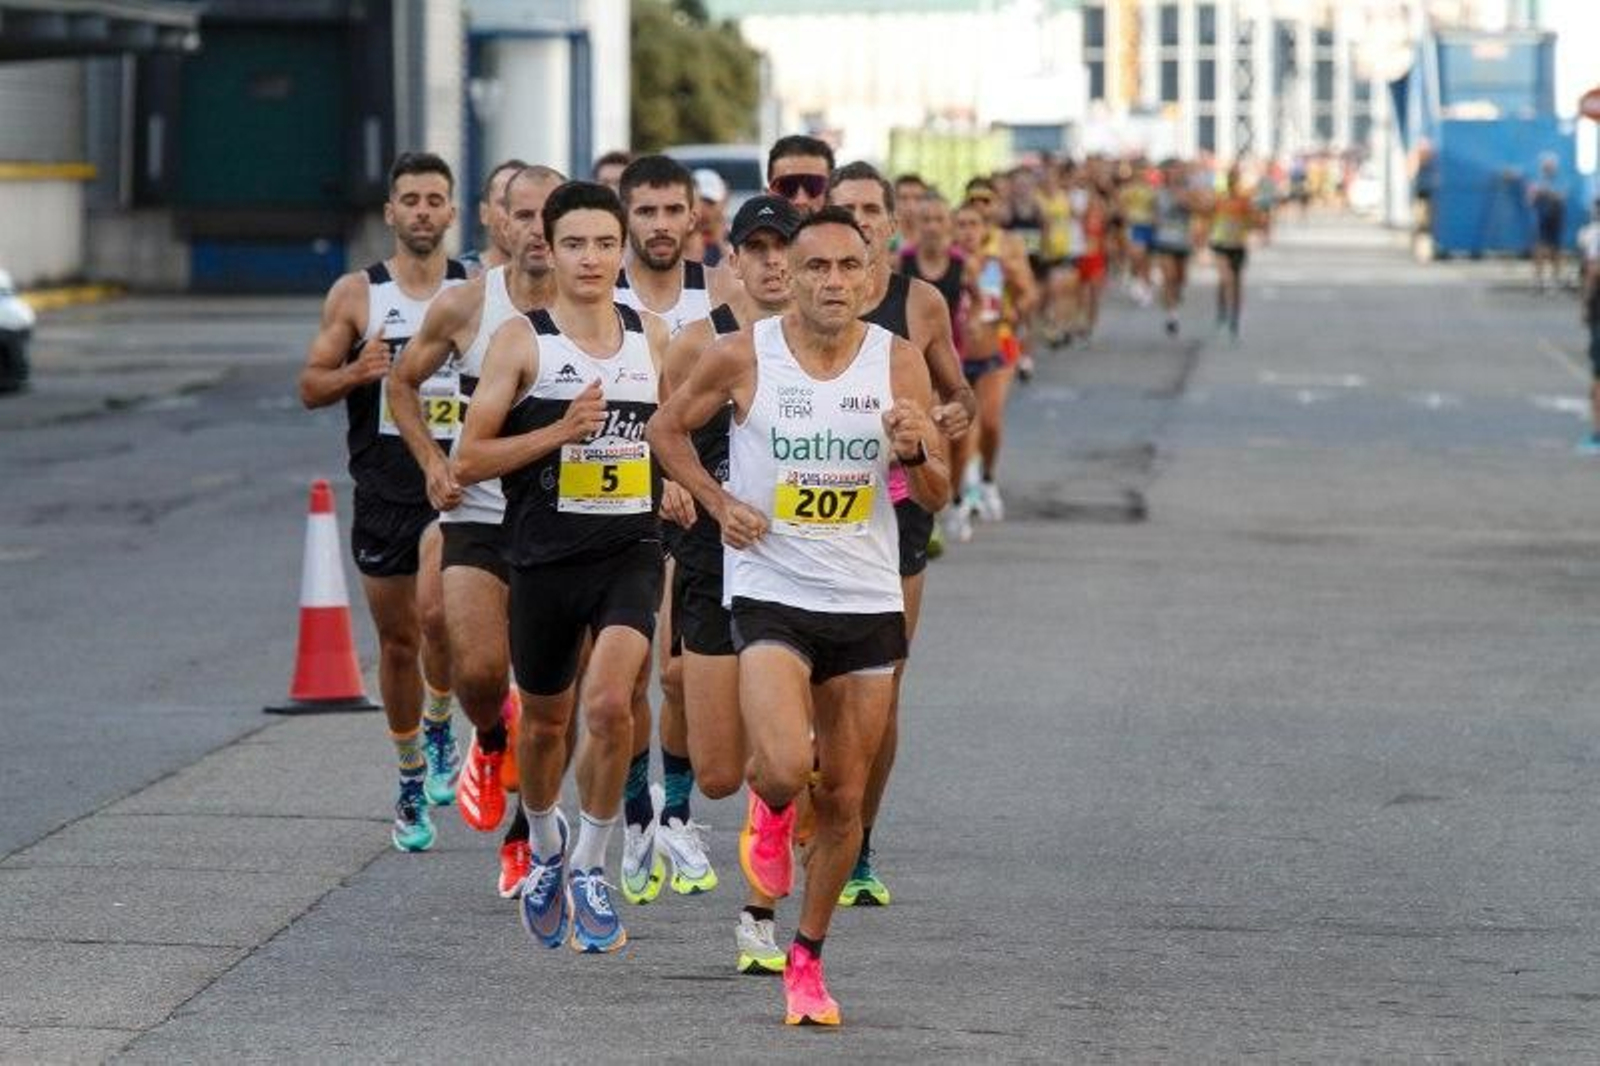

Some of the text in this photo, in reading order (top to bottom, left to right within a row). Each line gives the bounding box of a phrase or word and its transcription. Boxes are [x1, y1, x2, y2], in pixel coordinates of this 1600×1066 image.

[779, 404, 812, 418] TEAM
[838, 395, 880, 410] JULIÁN
[771, 426, 880, 460] bathco
[601, 465, 618, 493] 5
[795, 489, 858, 518] 207
